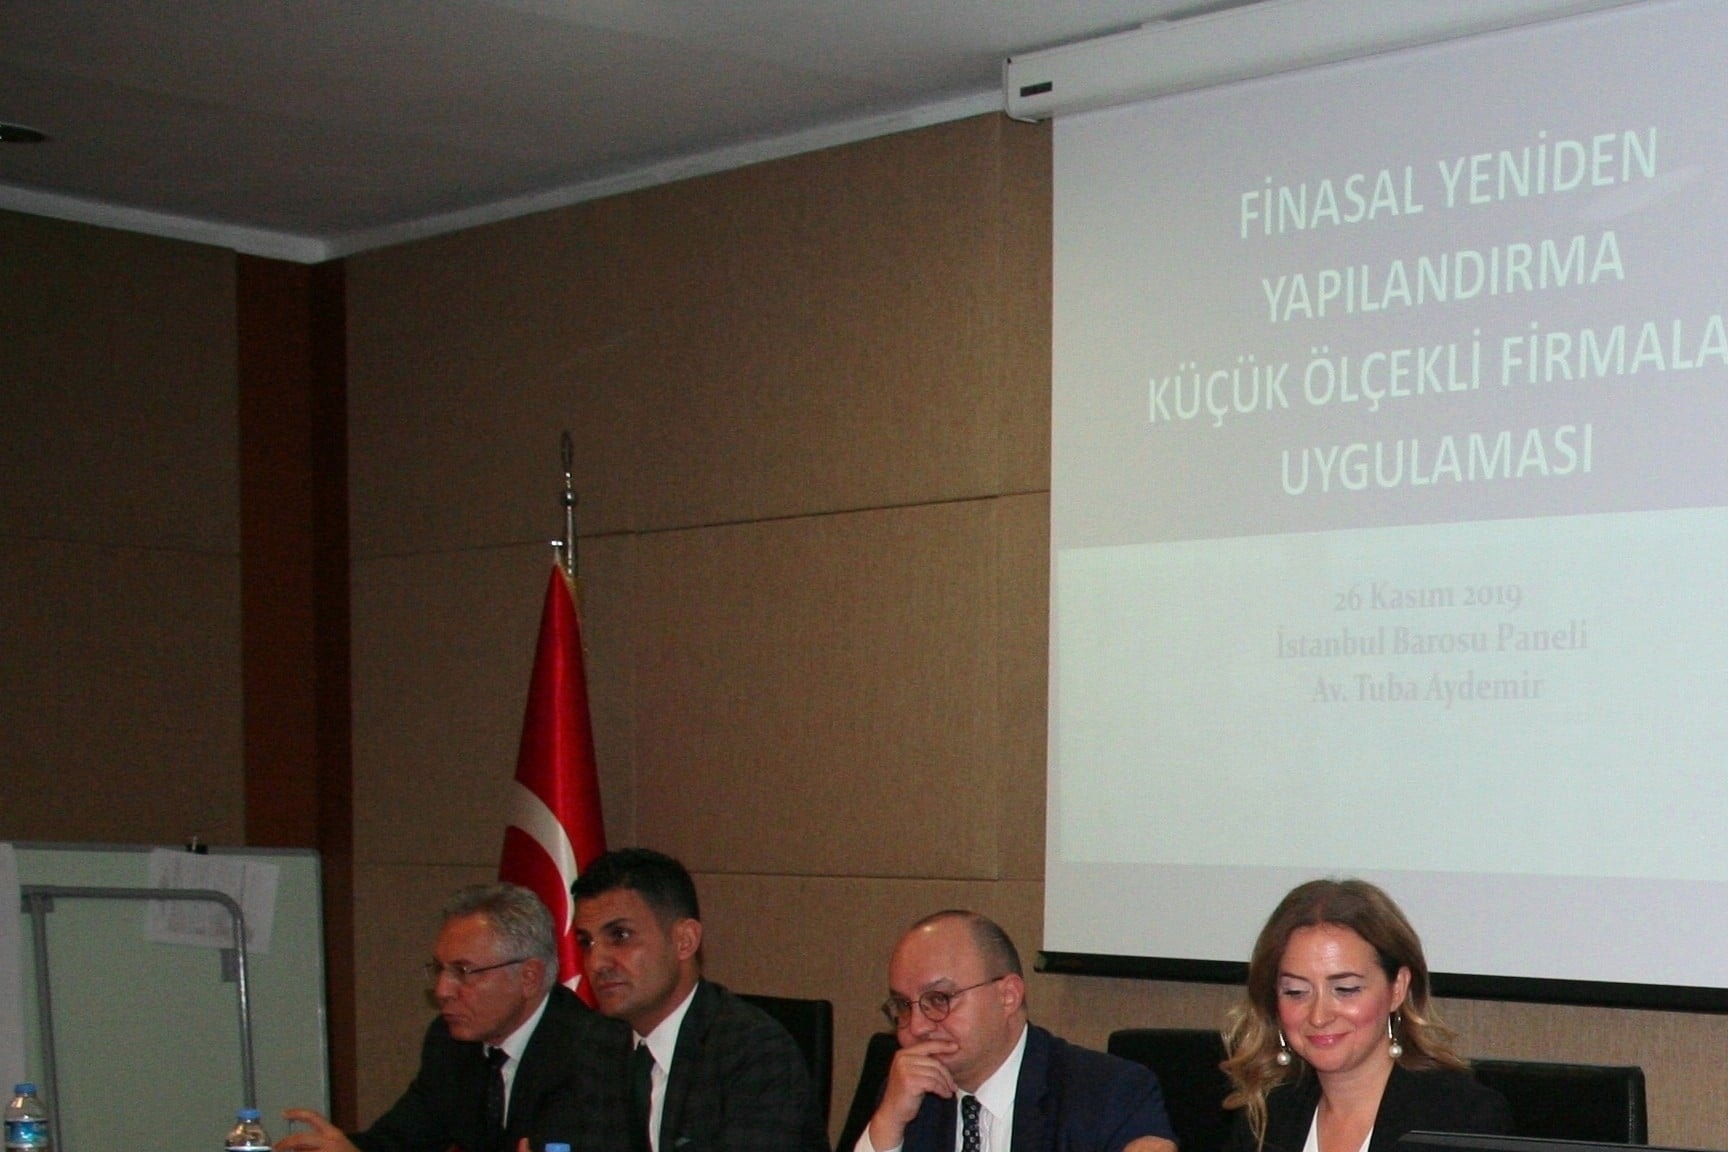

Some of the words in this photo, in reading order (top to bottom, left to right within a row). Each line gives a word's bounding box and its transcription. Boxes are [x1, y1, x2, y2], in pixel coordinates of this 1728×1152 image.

[1239, 164, 1424, 239] FİNASAL
[1438, 127, 1658, 209] YENİDEN
[1262, 230, 1626, 323] YAPILANDIRMA
[1148, 355, 1290, 427] KÜÇÜK
[1303, 327, 1482, 412] ÖLÇEKLİ
[1280, 423, 1594, 495] UYGULAMASI
[1334, 588, 1362, 612] 26
[1371, 581, 1454, 611] Kasım
[1464, 583, 1524, 612] 2019
[1393, 624, 1488, 656] Barosu
[1498, 619, 1588, 653] Paneli
[1313, 679, 1348, 703] Av.
[1354, 672, 1421, 702] Tuba
[1424, 670, 1545, 709] Aydemir
